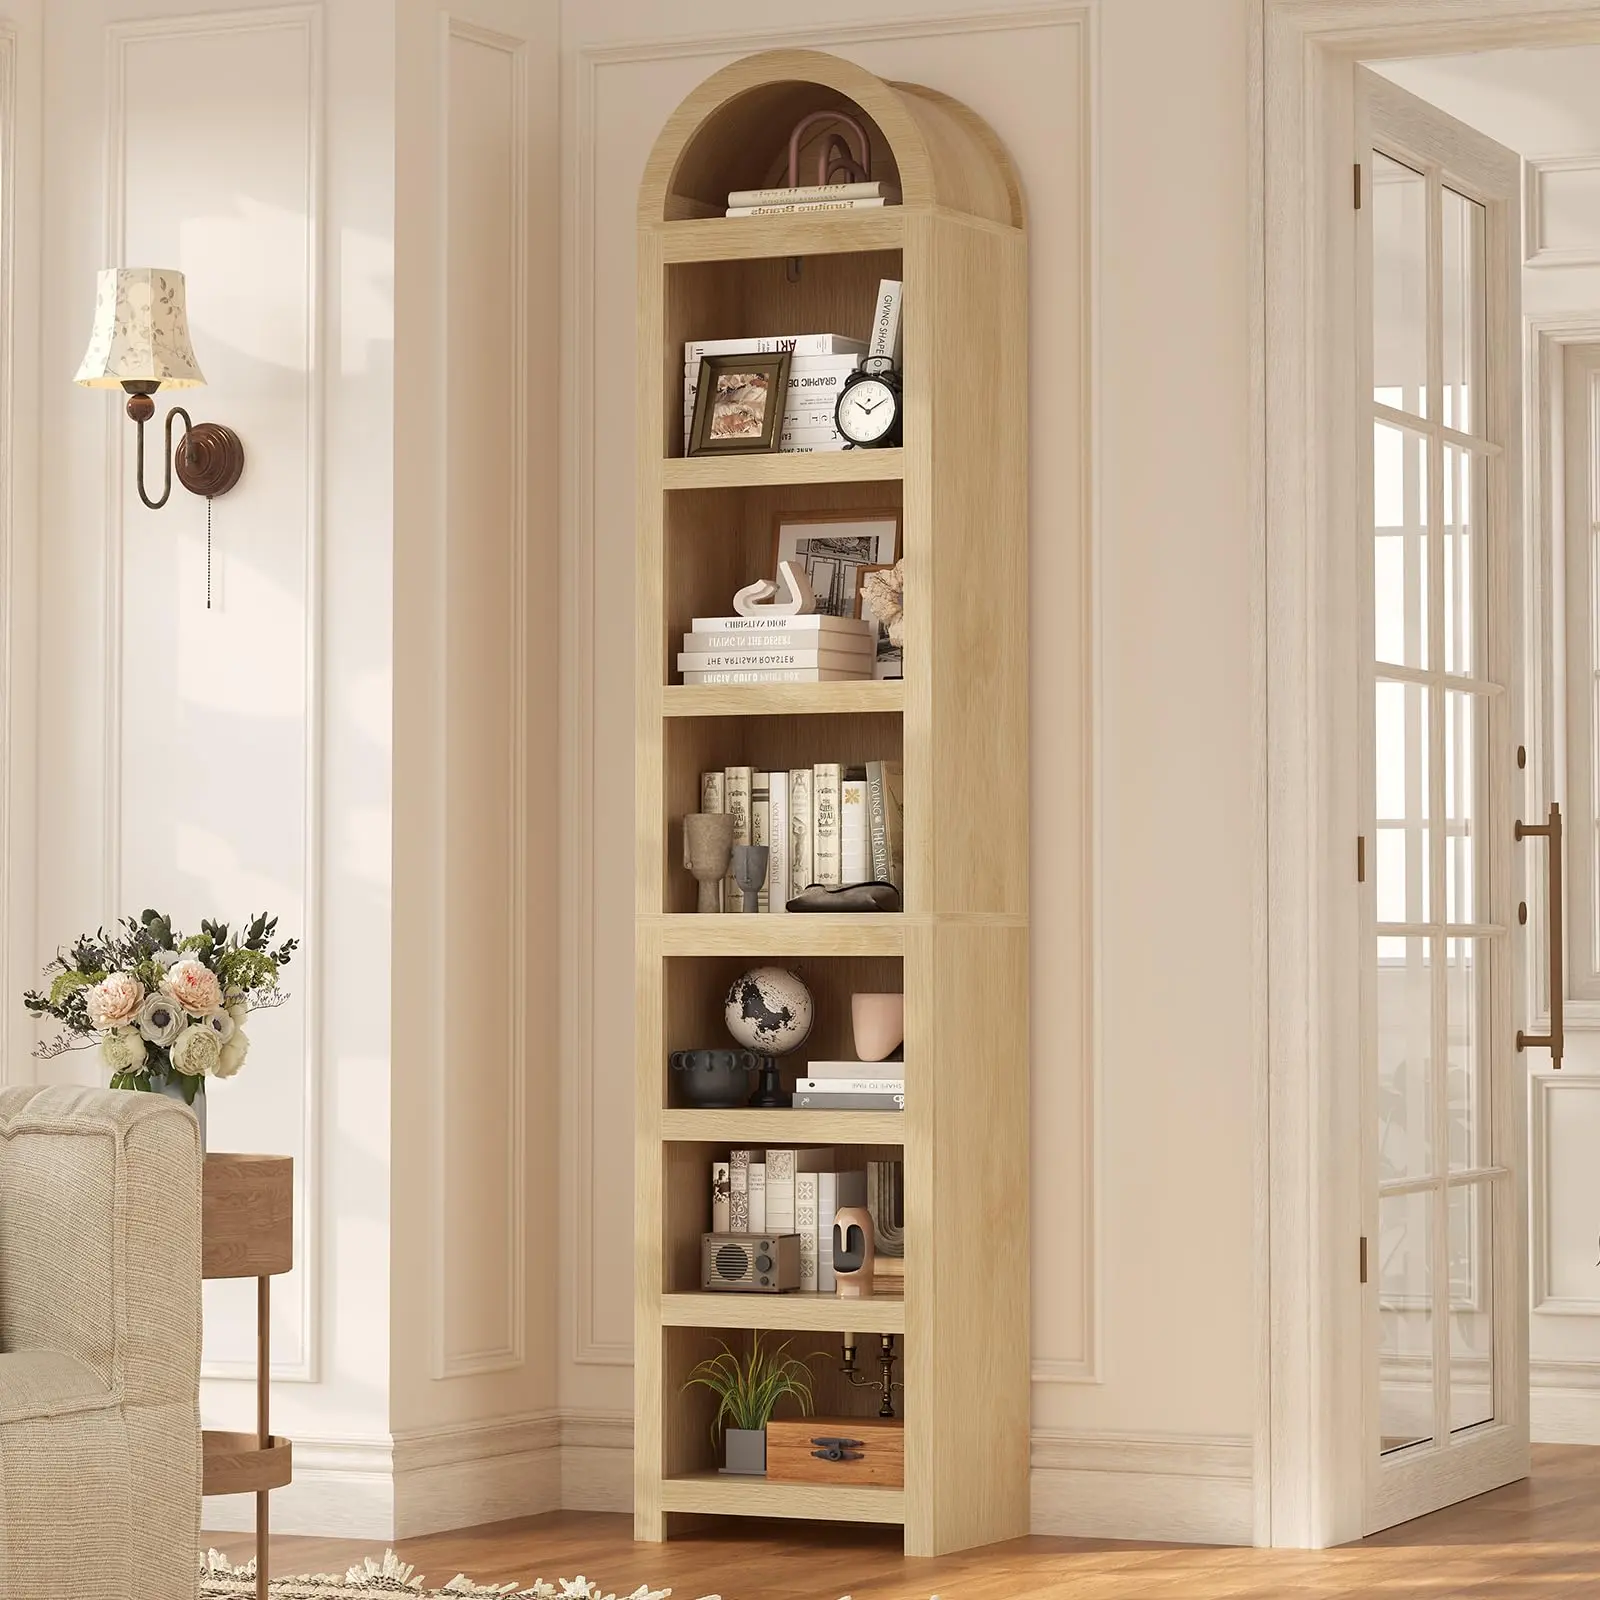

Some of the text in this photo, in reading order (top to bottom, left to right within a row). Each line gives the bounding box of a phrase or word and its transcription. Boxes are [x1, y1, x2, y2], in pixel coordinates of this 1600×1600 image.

[880, 294, 893, 326] GIVING
[876, 327, 888, 354] SHAPE
[801, 377, 837, 387] GRAPHIC
[771, 801, 780, 885] JUMBO COLLECTION
[870, 778, 888, 881] YOUNG THE SHACK
